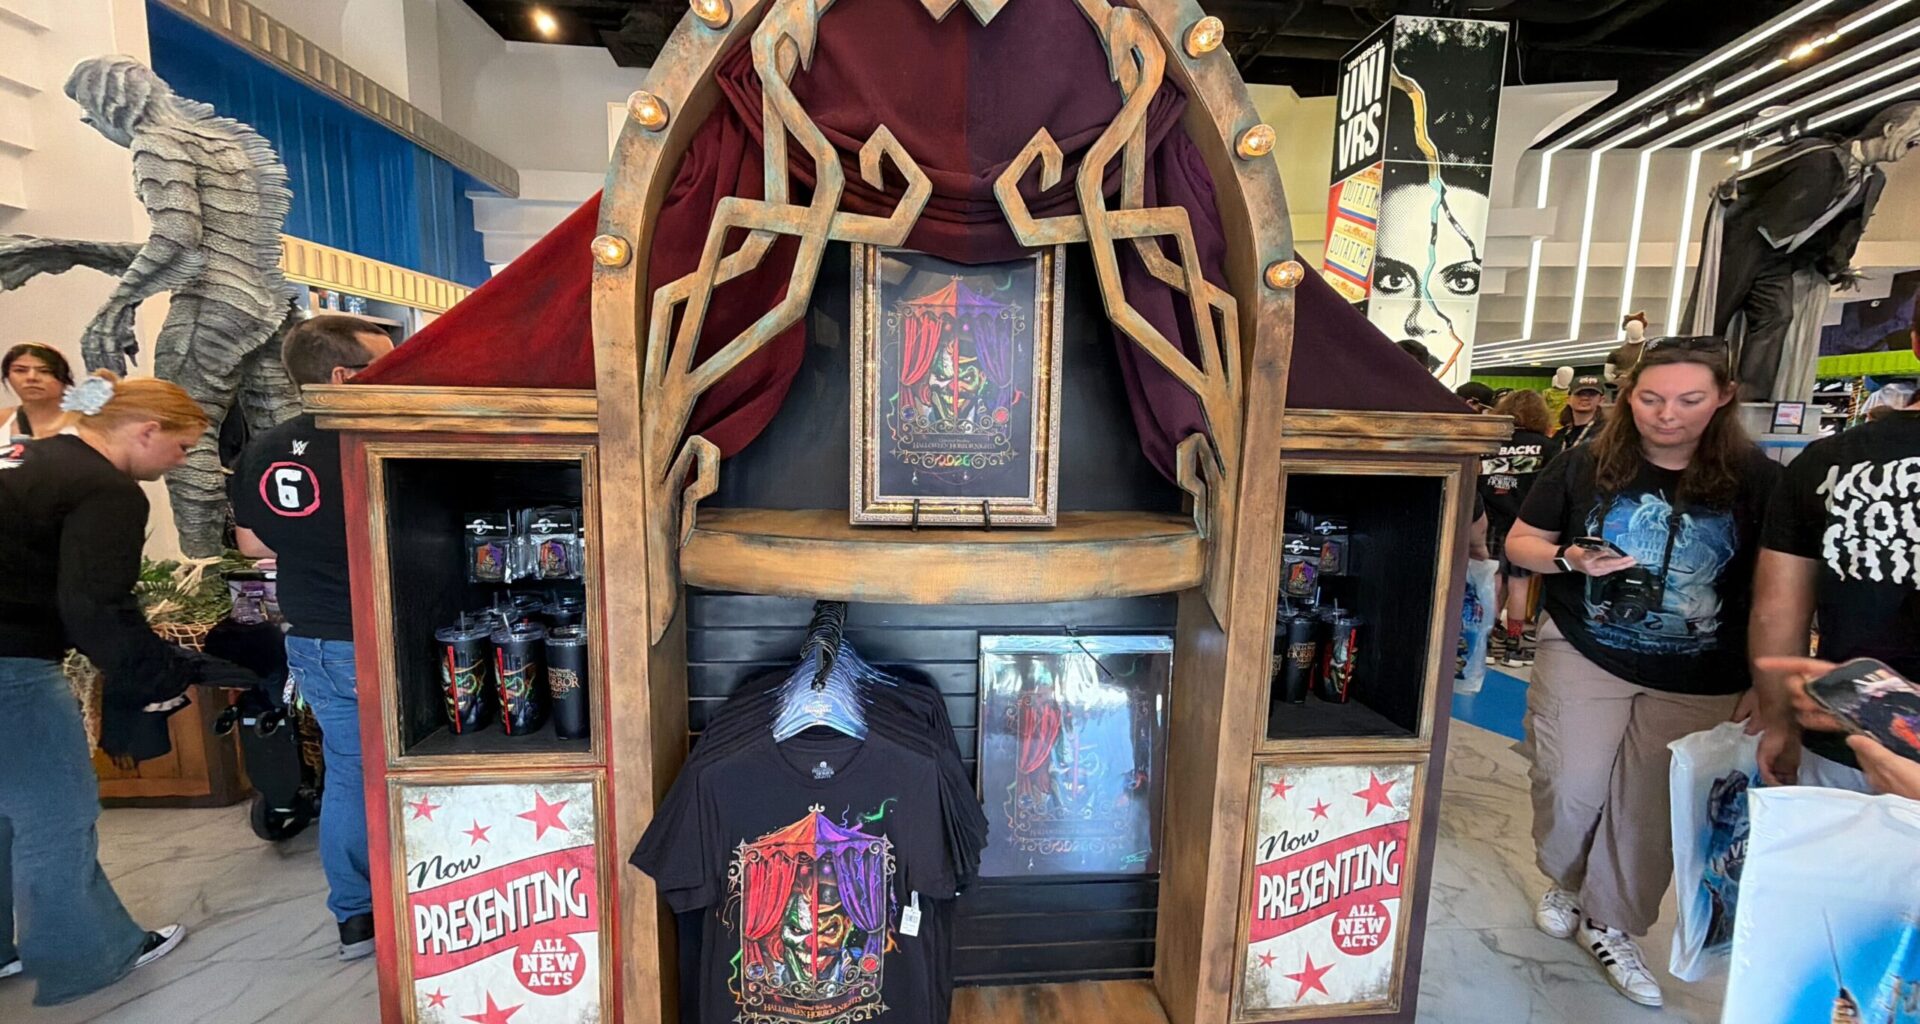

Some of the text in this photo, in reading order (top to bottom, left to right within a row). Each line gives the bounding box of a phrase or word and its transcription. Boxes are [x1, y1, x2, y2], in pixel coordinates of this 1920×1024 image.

[1340, 46, 1385, 121] UNI
[1338, 102, 1382, 172] VRS
[1499, 445, 1542, 455] BACK!
[275, 468, 302, 509] 6
[1259, 829, 1319, 860] Now
[407, 855, 481, 888] Now
[1257, 840, 1399, 920] PRESENTING
[413, 867, 588, 955] PRESENTING
[1348, 904, 1376, 917] ALL
[1337, 916, 1386, 936] NEW
[531, 938, 566, 953] ALL
[1341, 935, 1378, 948] ACTS
[520, 952, 579, 973] NEW
[528, 972, 573, 987] ACTS
